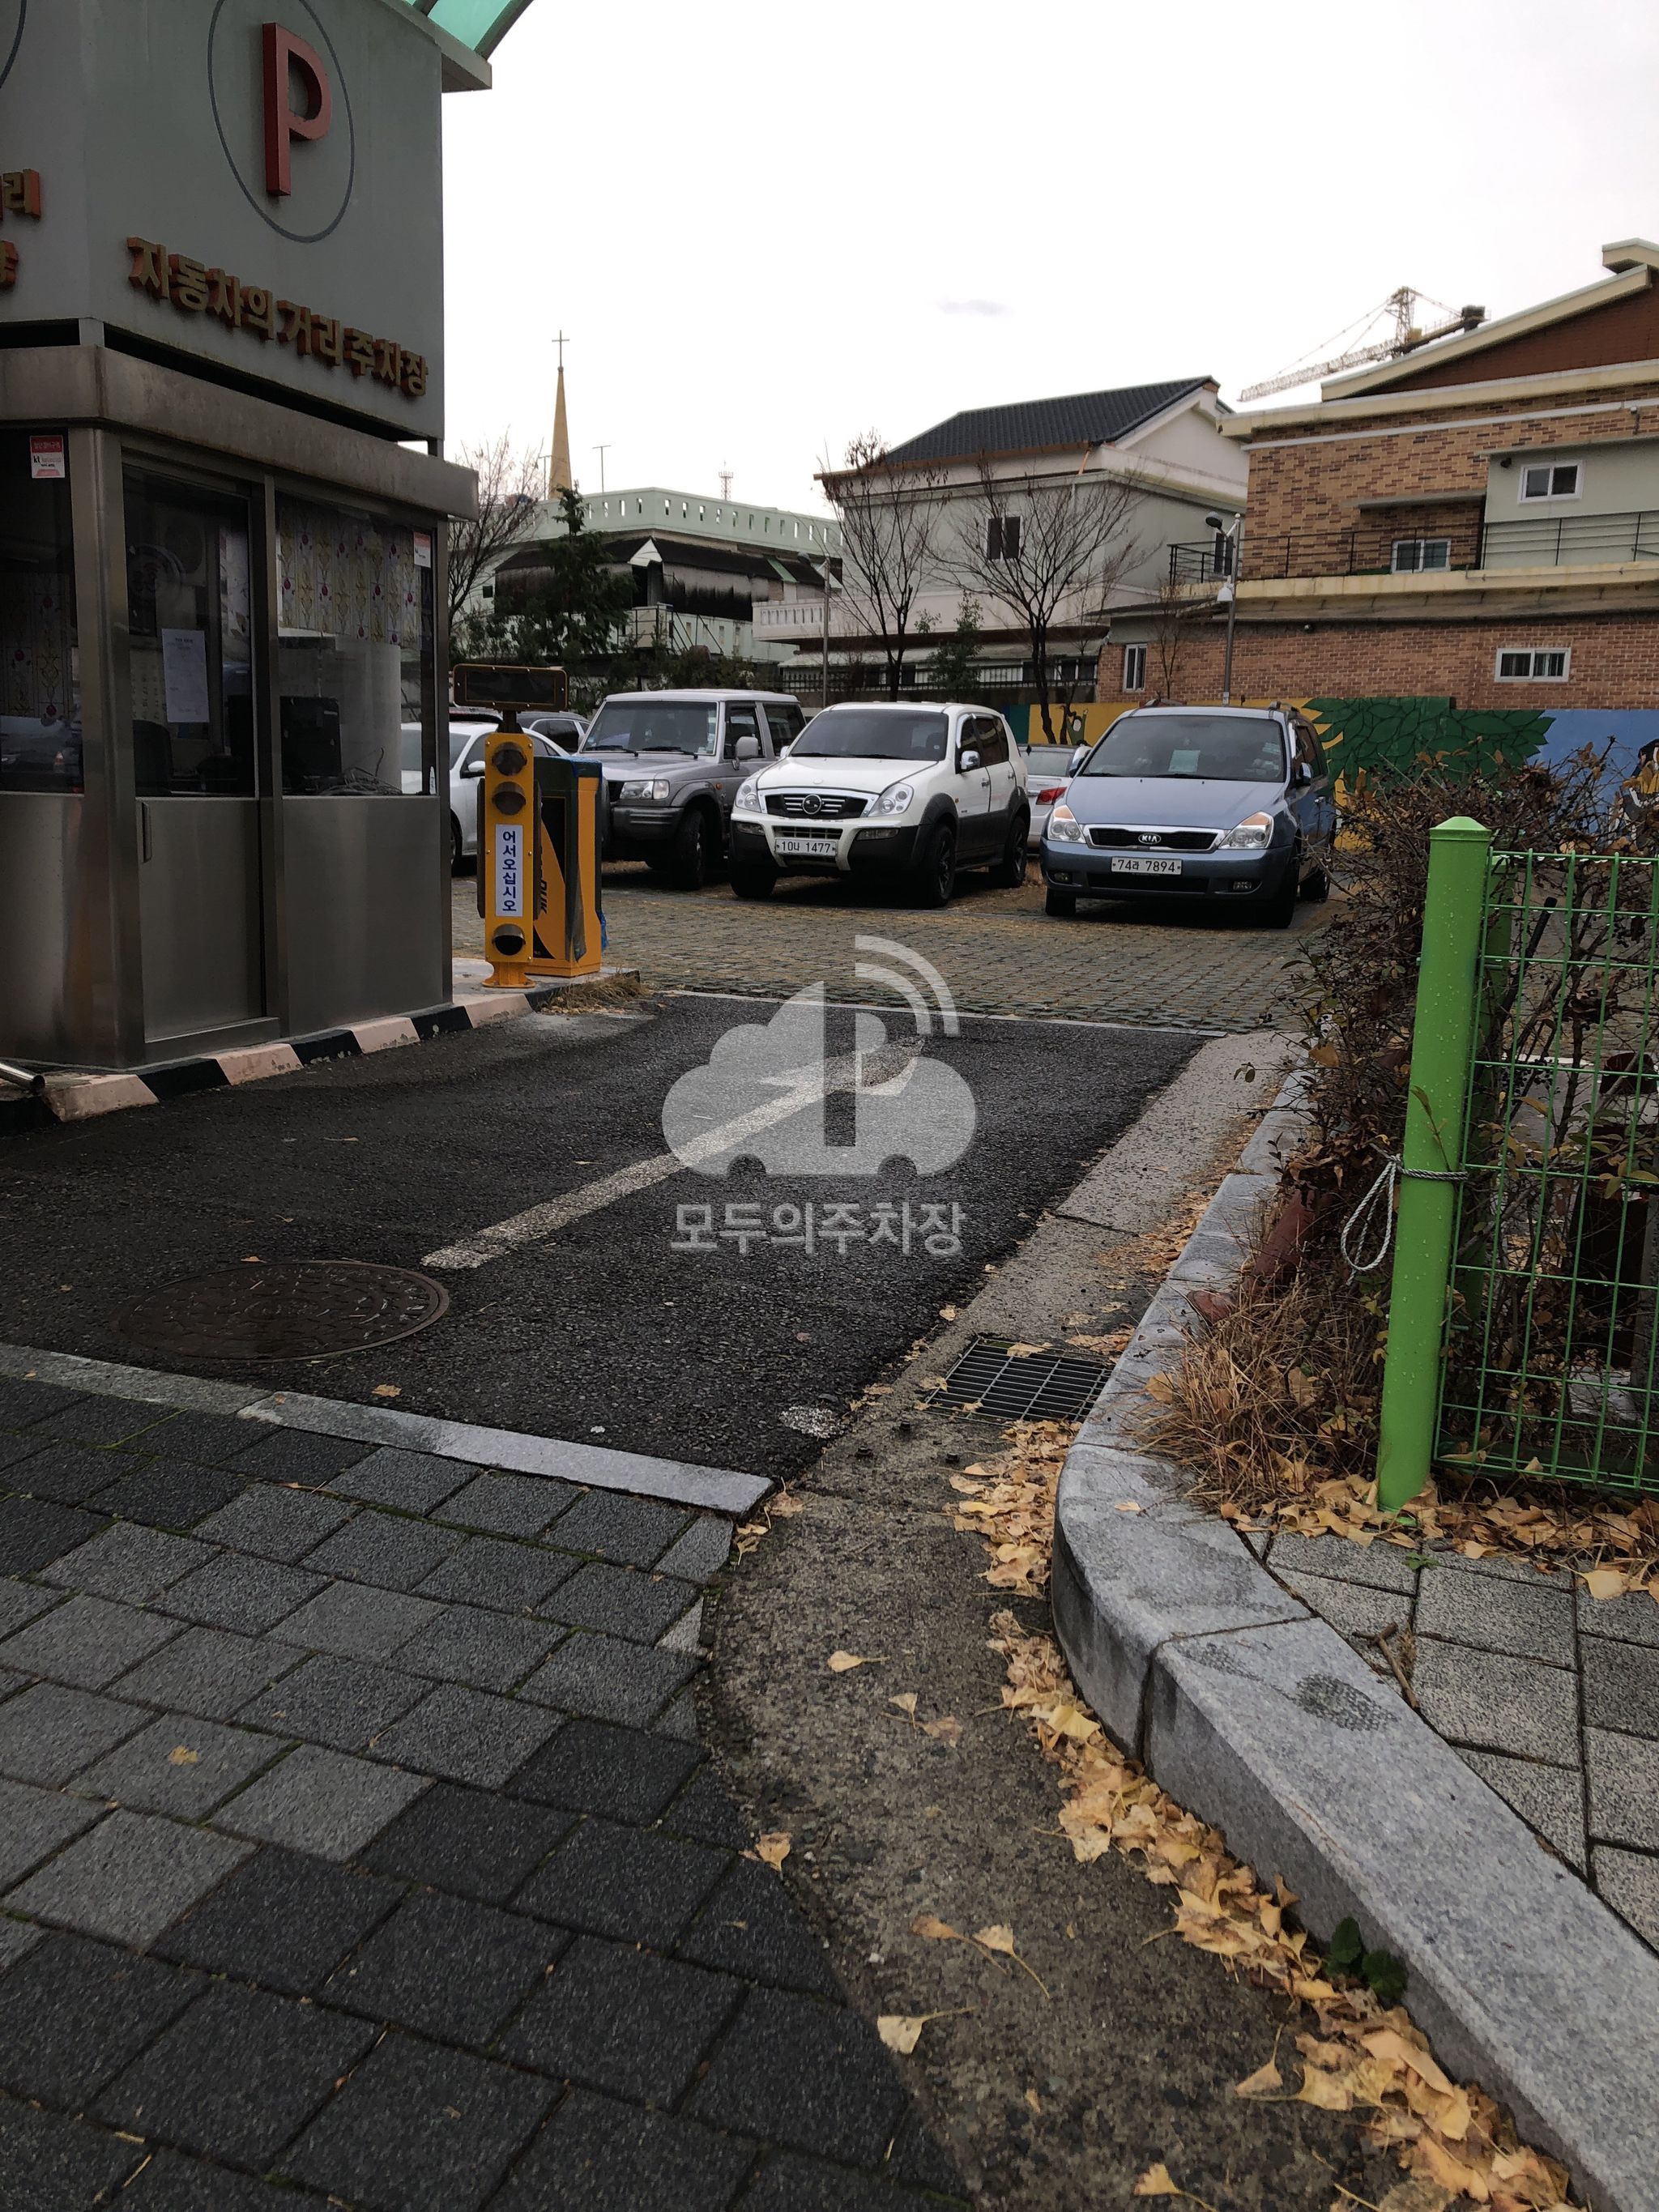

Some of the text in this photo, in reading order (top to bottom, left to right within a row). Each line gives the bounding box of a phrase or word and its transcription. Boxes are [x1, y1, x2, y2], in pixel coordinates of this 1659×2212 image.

[262, 23, 332, 195] P
[0, 168, 41, 220] 리
[502, 830, 517, 912] 어서오십시오
[806, 842, 831, 853] 1477
[1118, 859, 1175, 872] 74라 7894
